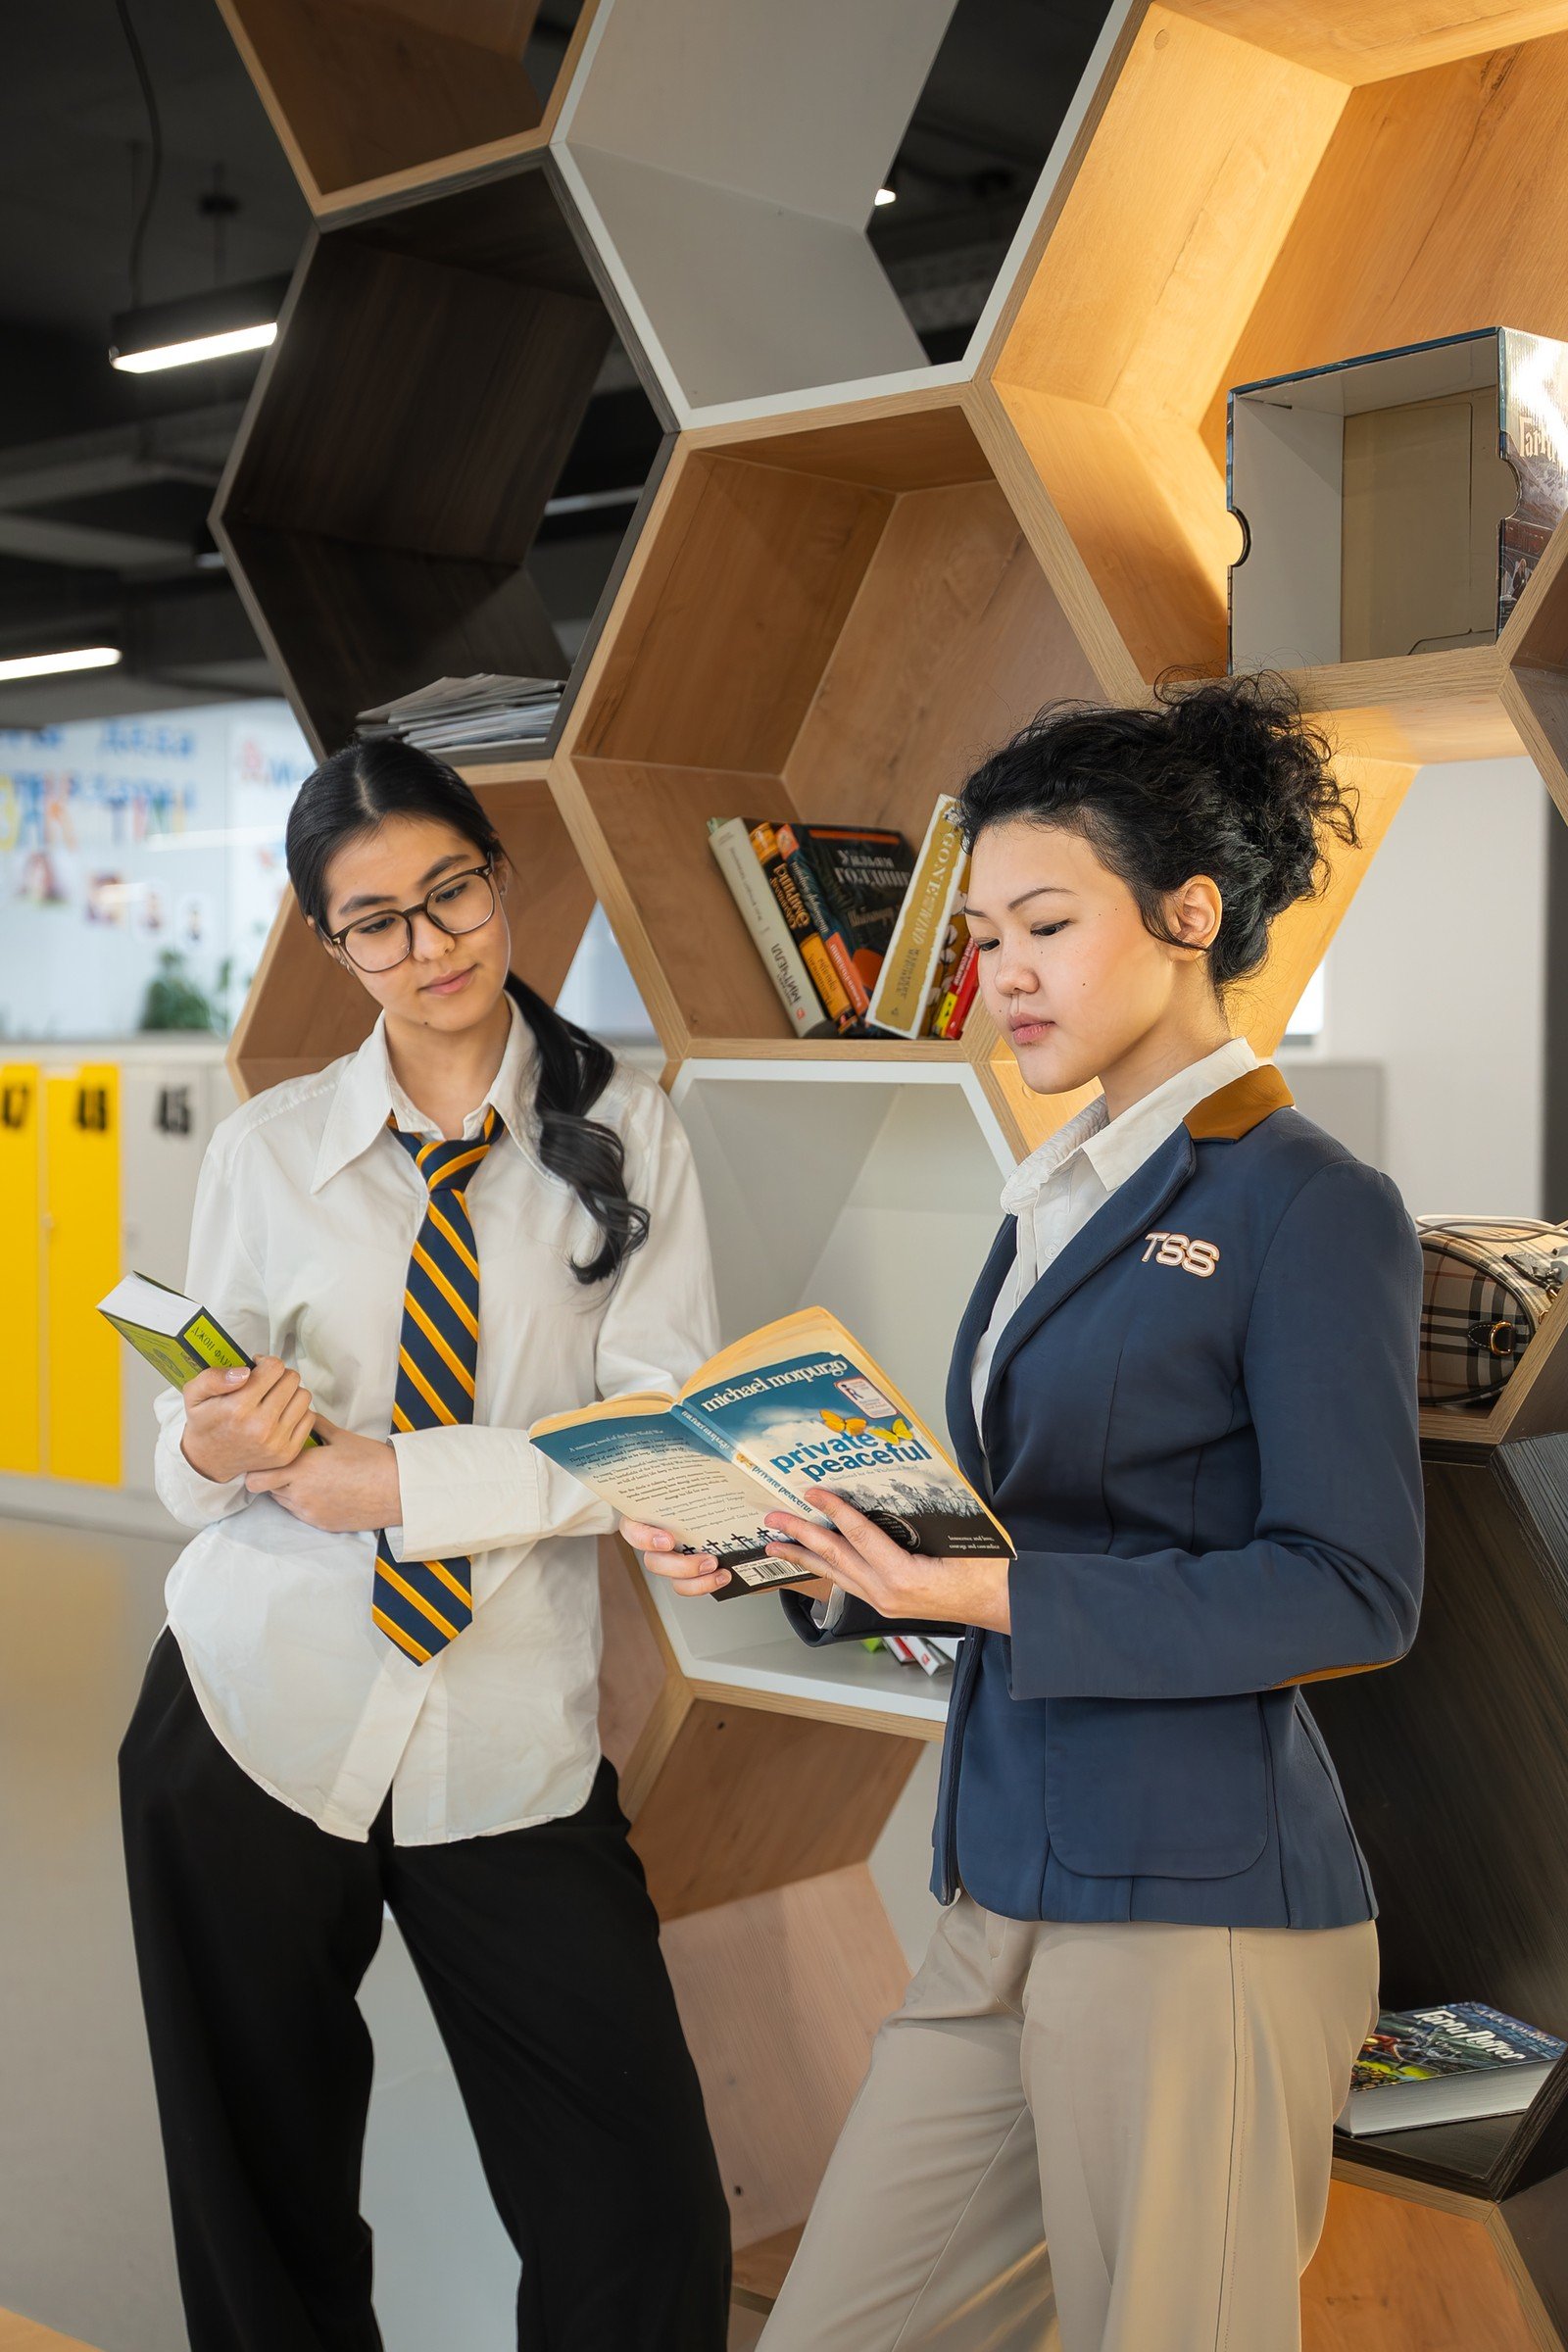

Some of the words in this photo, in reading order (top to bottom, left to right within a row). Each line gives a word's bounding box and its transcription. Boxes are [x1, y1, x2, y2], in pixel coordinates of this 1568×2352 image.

[928, 832, 956, 896] GONE
[1141, 1232, 1220, 1277] TSS
[701, 1377, 771, 1412] michael
[766, 1360, 849, 1389] morpurgo
[769, 1431, 879, 1475] private
[801, 1438, 933, 1483] peaceful
